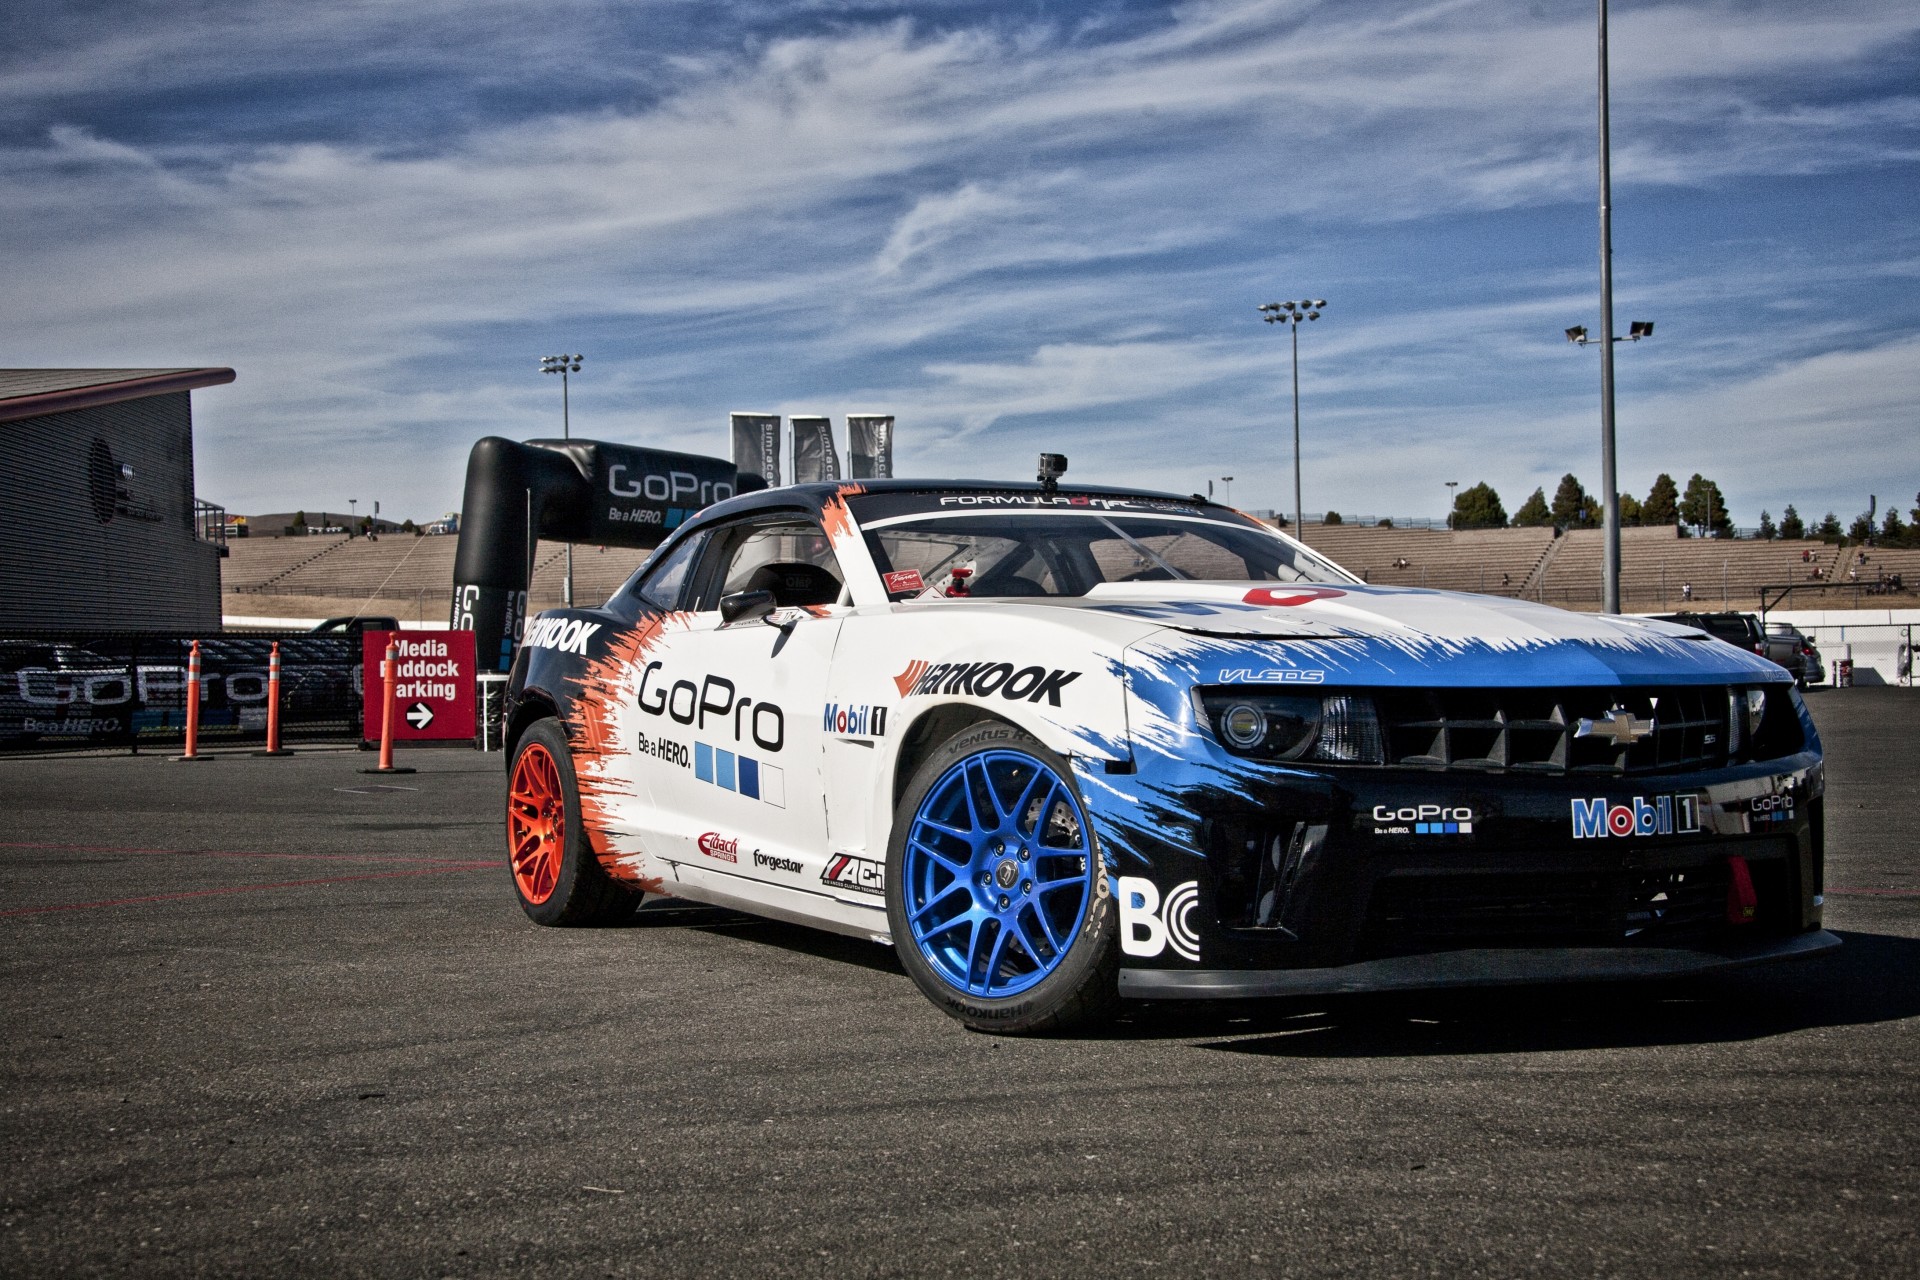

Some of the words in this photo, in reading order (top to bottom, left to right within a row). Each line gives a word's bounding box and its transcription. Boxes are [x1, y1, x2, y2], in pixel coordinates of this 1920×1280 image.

[608, 464, 733, 505] GoPro
[608, 507, 622, 520] Be
[623, 510, 629, 521] a
[629, 508, 662, 524] HERO.
[395, 639, 448, 657] Media
[16, 666, 268, 705] GoPro
[1218, 668, 1325, 684] VLEDS
[396, 680, 456, 701] arking
[638, 660, 784, 753] GoPro
[824, 703, 869, 735] Mobil
[638, 731, 649, 753] Be
[650, 741, 656, 756] a
[657, 737, 690, 769] HERO.
[1372, 804, 1472, 821] GoPro
[1751, 795, 1794, 811] GoPro
[1571, 796, 1673, 839] Mobil
[697, 831, 738, 858] Eibach
[710, 849, 736, 861] SPRINGS
[753, 848, 804, 874] forgestar
[844, 883, 861, 892] CLUTCH
